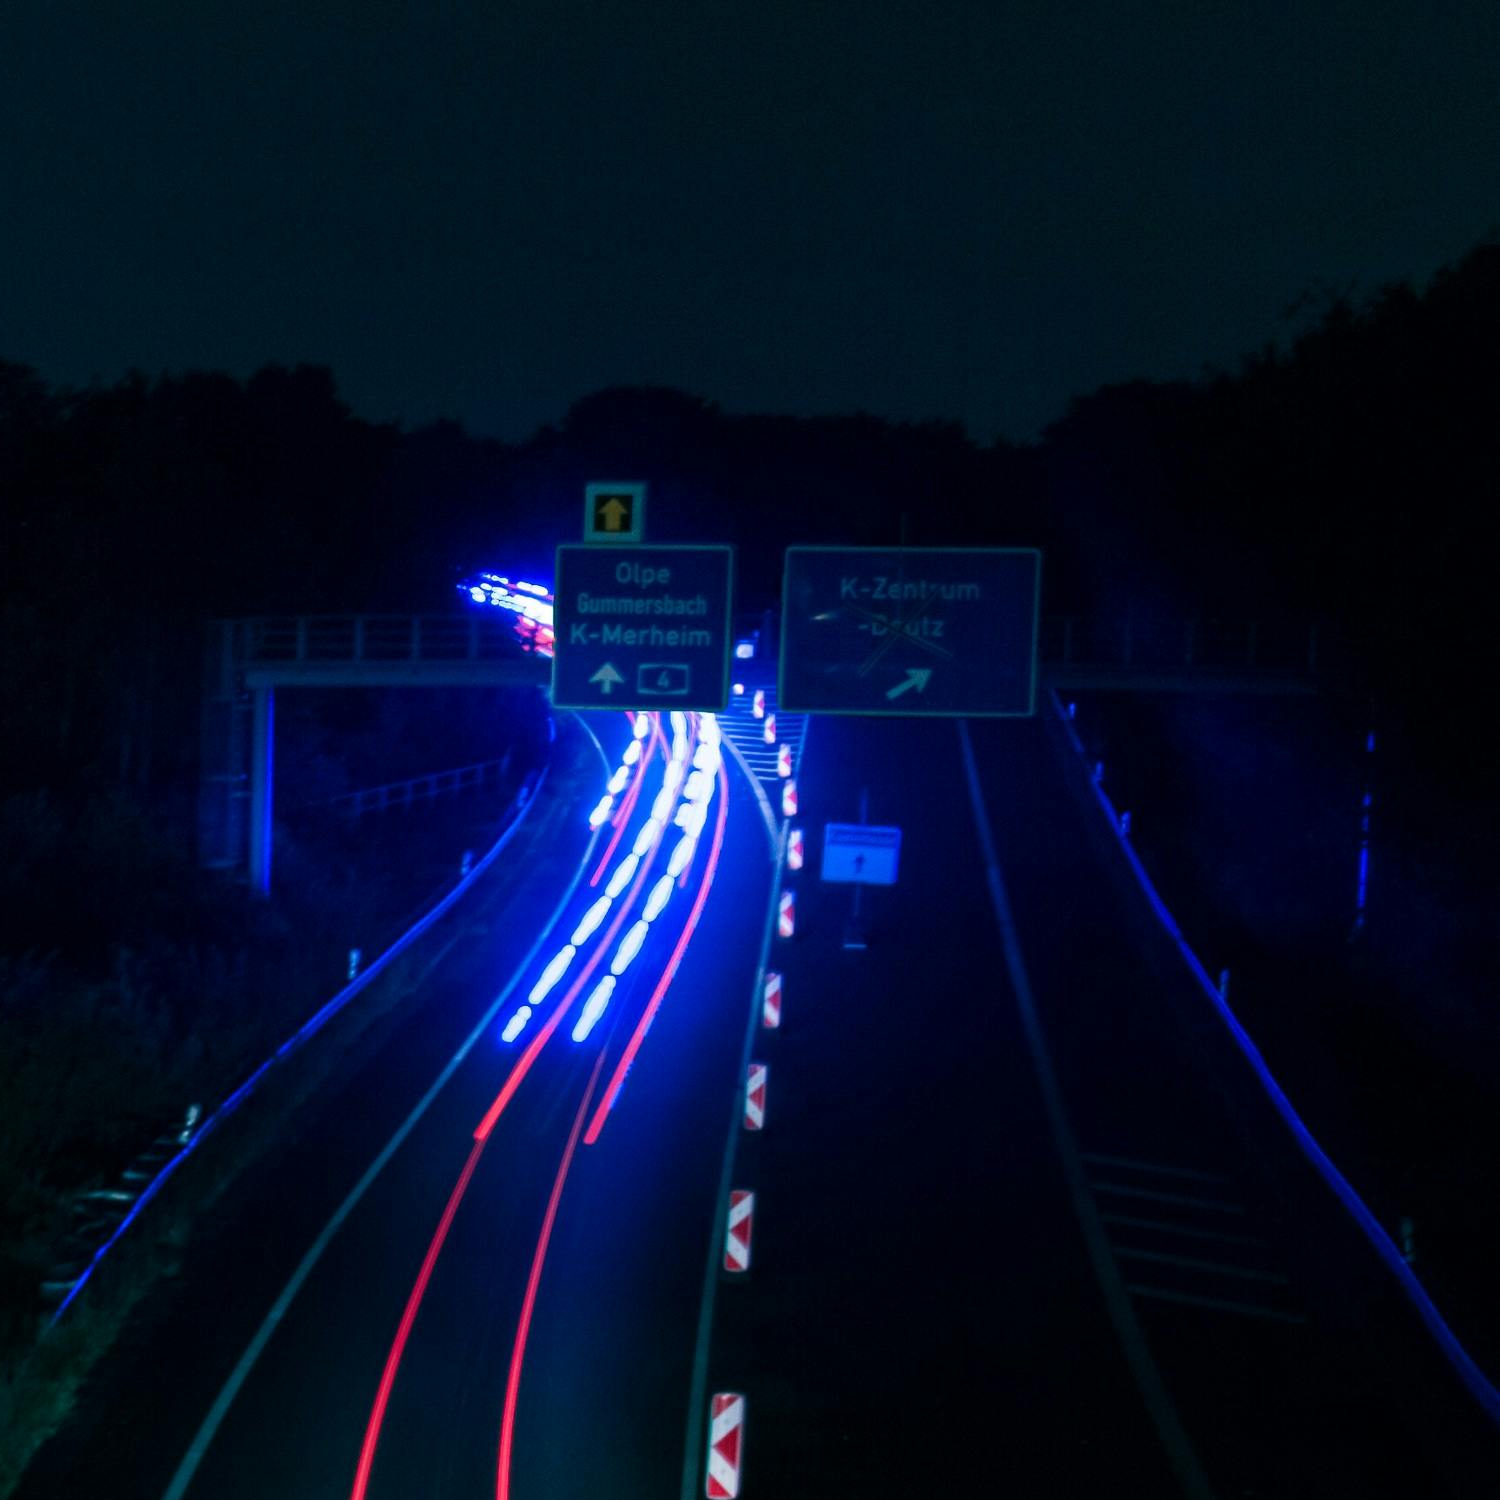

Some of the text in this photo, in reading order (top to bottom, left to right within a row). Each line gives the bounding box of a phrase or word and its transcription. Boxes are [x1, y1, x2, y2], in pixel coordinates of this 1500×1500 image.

[615, 561, 670, 589] Olpe
[839, 577, 980, 600] K-Zentrum
[577, 593, 707, 615] Gummersbach
[569, 624, 711, 647] K-Merheim
[657, 671, 671, 690] 4
